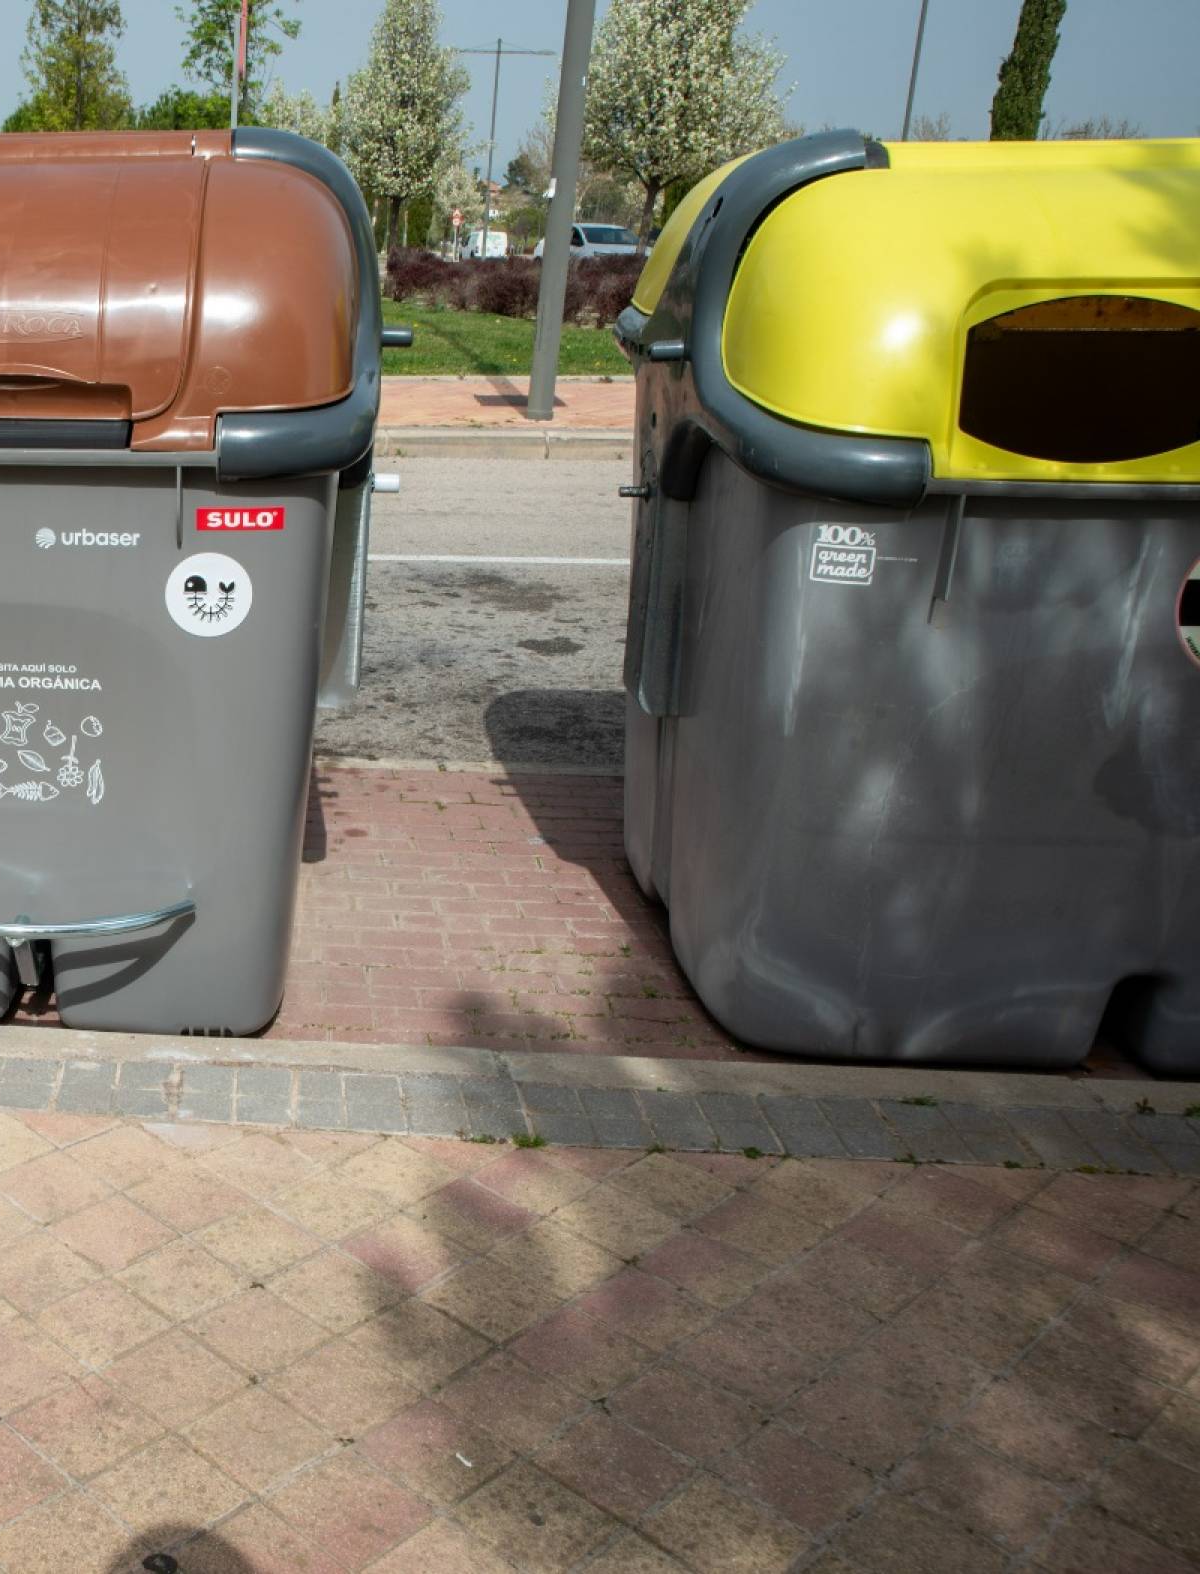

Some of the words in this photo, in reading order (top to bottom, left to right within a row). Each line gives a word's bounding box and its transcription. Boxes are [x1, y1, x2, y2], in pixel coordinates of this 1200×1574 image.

[206, 511, 274, 528] SULO
[61, 528, 141, 548] urbaser
[816, 524, 876, 546] 100%
[818, 550, 868, 564] green
[816, 563, 868, 578] made
[21, 662, 46, 674] AQUÍ
[48, 664, 78, 674] SOLO
[18, 675, 103, 691] ORGÁNICA
